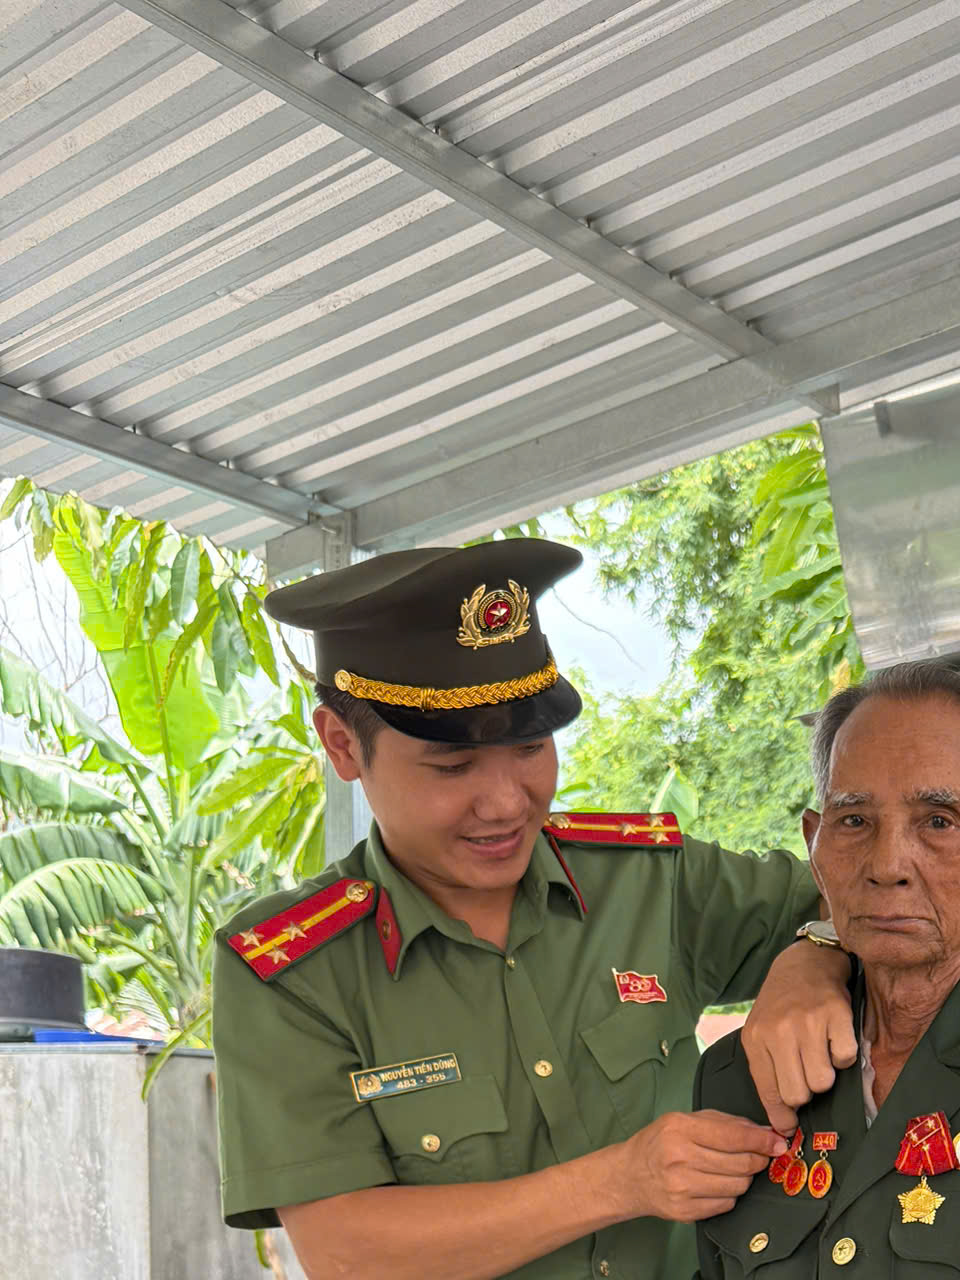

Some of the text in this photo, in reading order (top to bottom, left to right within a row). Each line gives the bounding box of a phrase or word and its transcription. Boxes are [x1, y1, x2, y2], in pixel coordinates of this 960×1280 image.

[379, 1066, 414, 1082] NGUYỄN
[414, 1061, 432, 1074] TIẾN
[396, 1078, 417, 1088] 483
